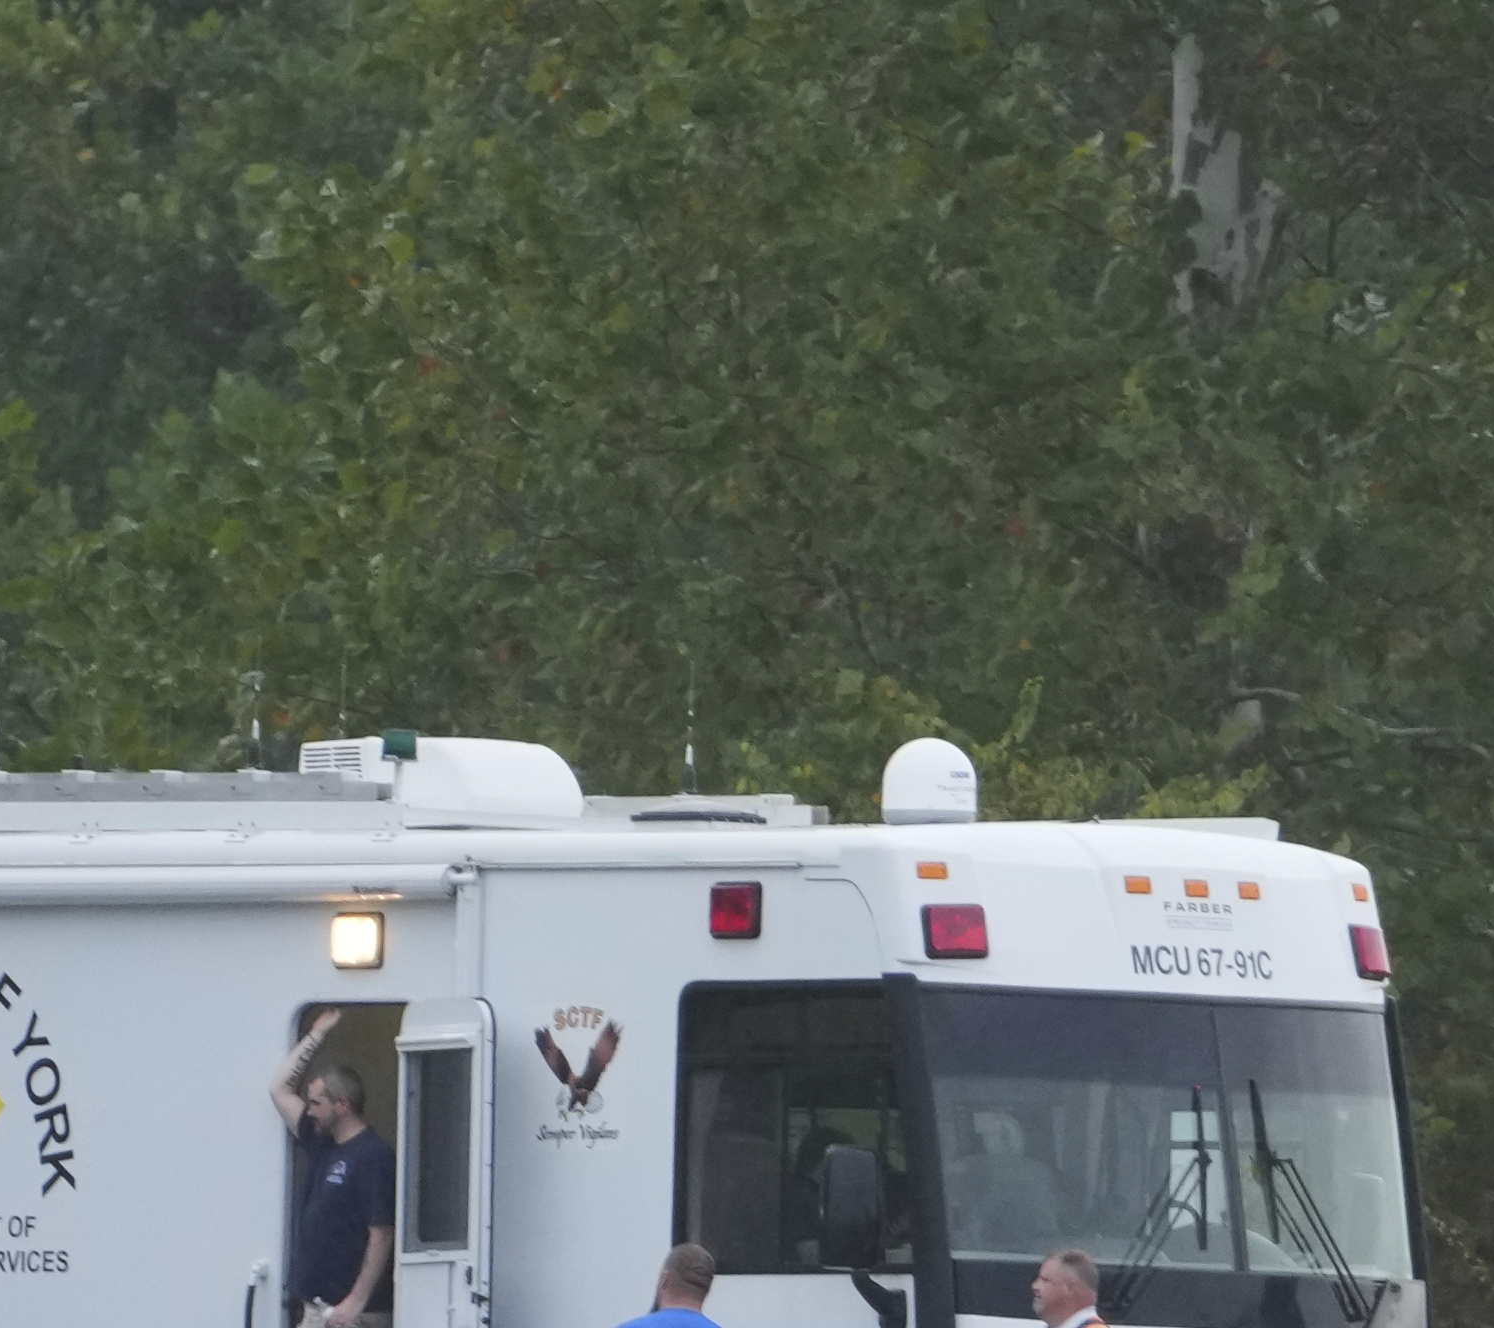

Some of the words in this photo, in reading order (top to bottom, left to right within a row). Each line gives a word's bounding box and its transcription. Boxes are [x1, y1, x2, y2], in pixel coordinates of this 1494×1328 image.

[1163, 901, 1234, 914] FARBER
[1130, 945, 1191, 975] MCU
[1197, 947, 1273, 980] 67-91C
[12, 1009, 77, 1197] YORK
[7, 1215, 37, 1238] OF
